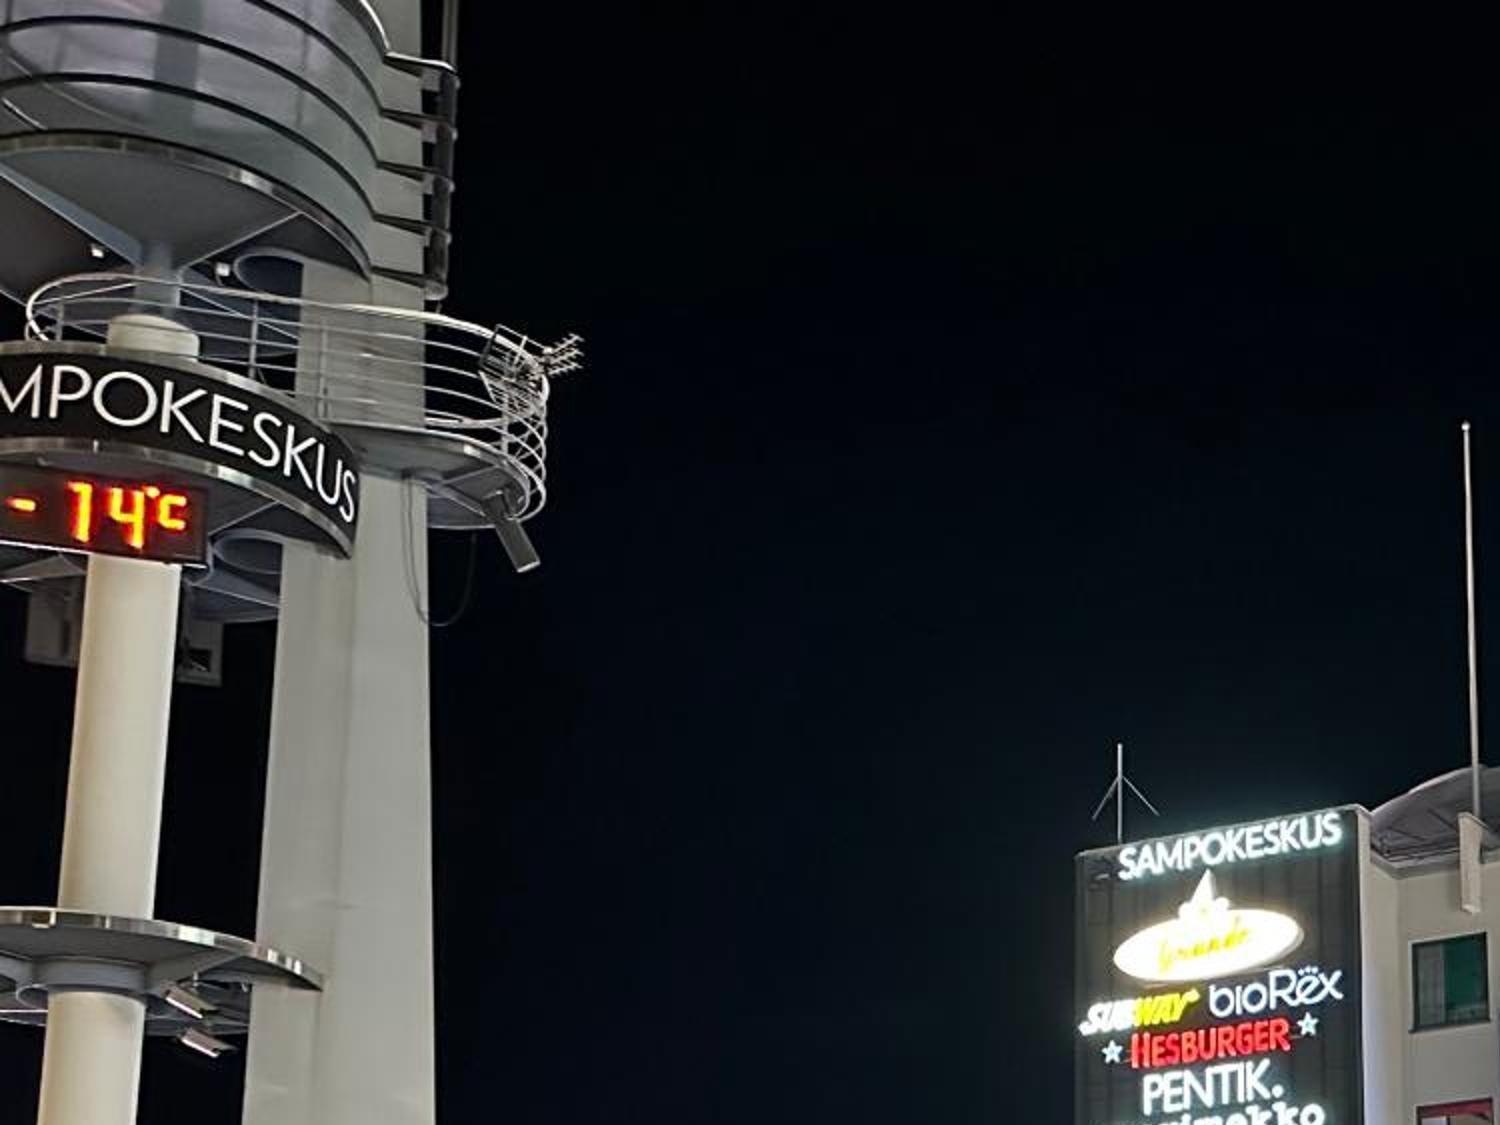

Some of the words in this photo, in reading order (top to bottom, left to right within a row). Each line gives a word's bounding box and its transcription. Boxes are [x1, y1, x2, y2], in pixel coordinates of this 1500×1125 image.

[1117, 812, 1343, 881] SAMPOKESKUS
[1079, 988, 1200, 1036] SUBWAY
[1130, 1016, 1291, 1069] HESBURGER
